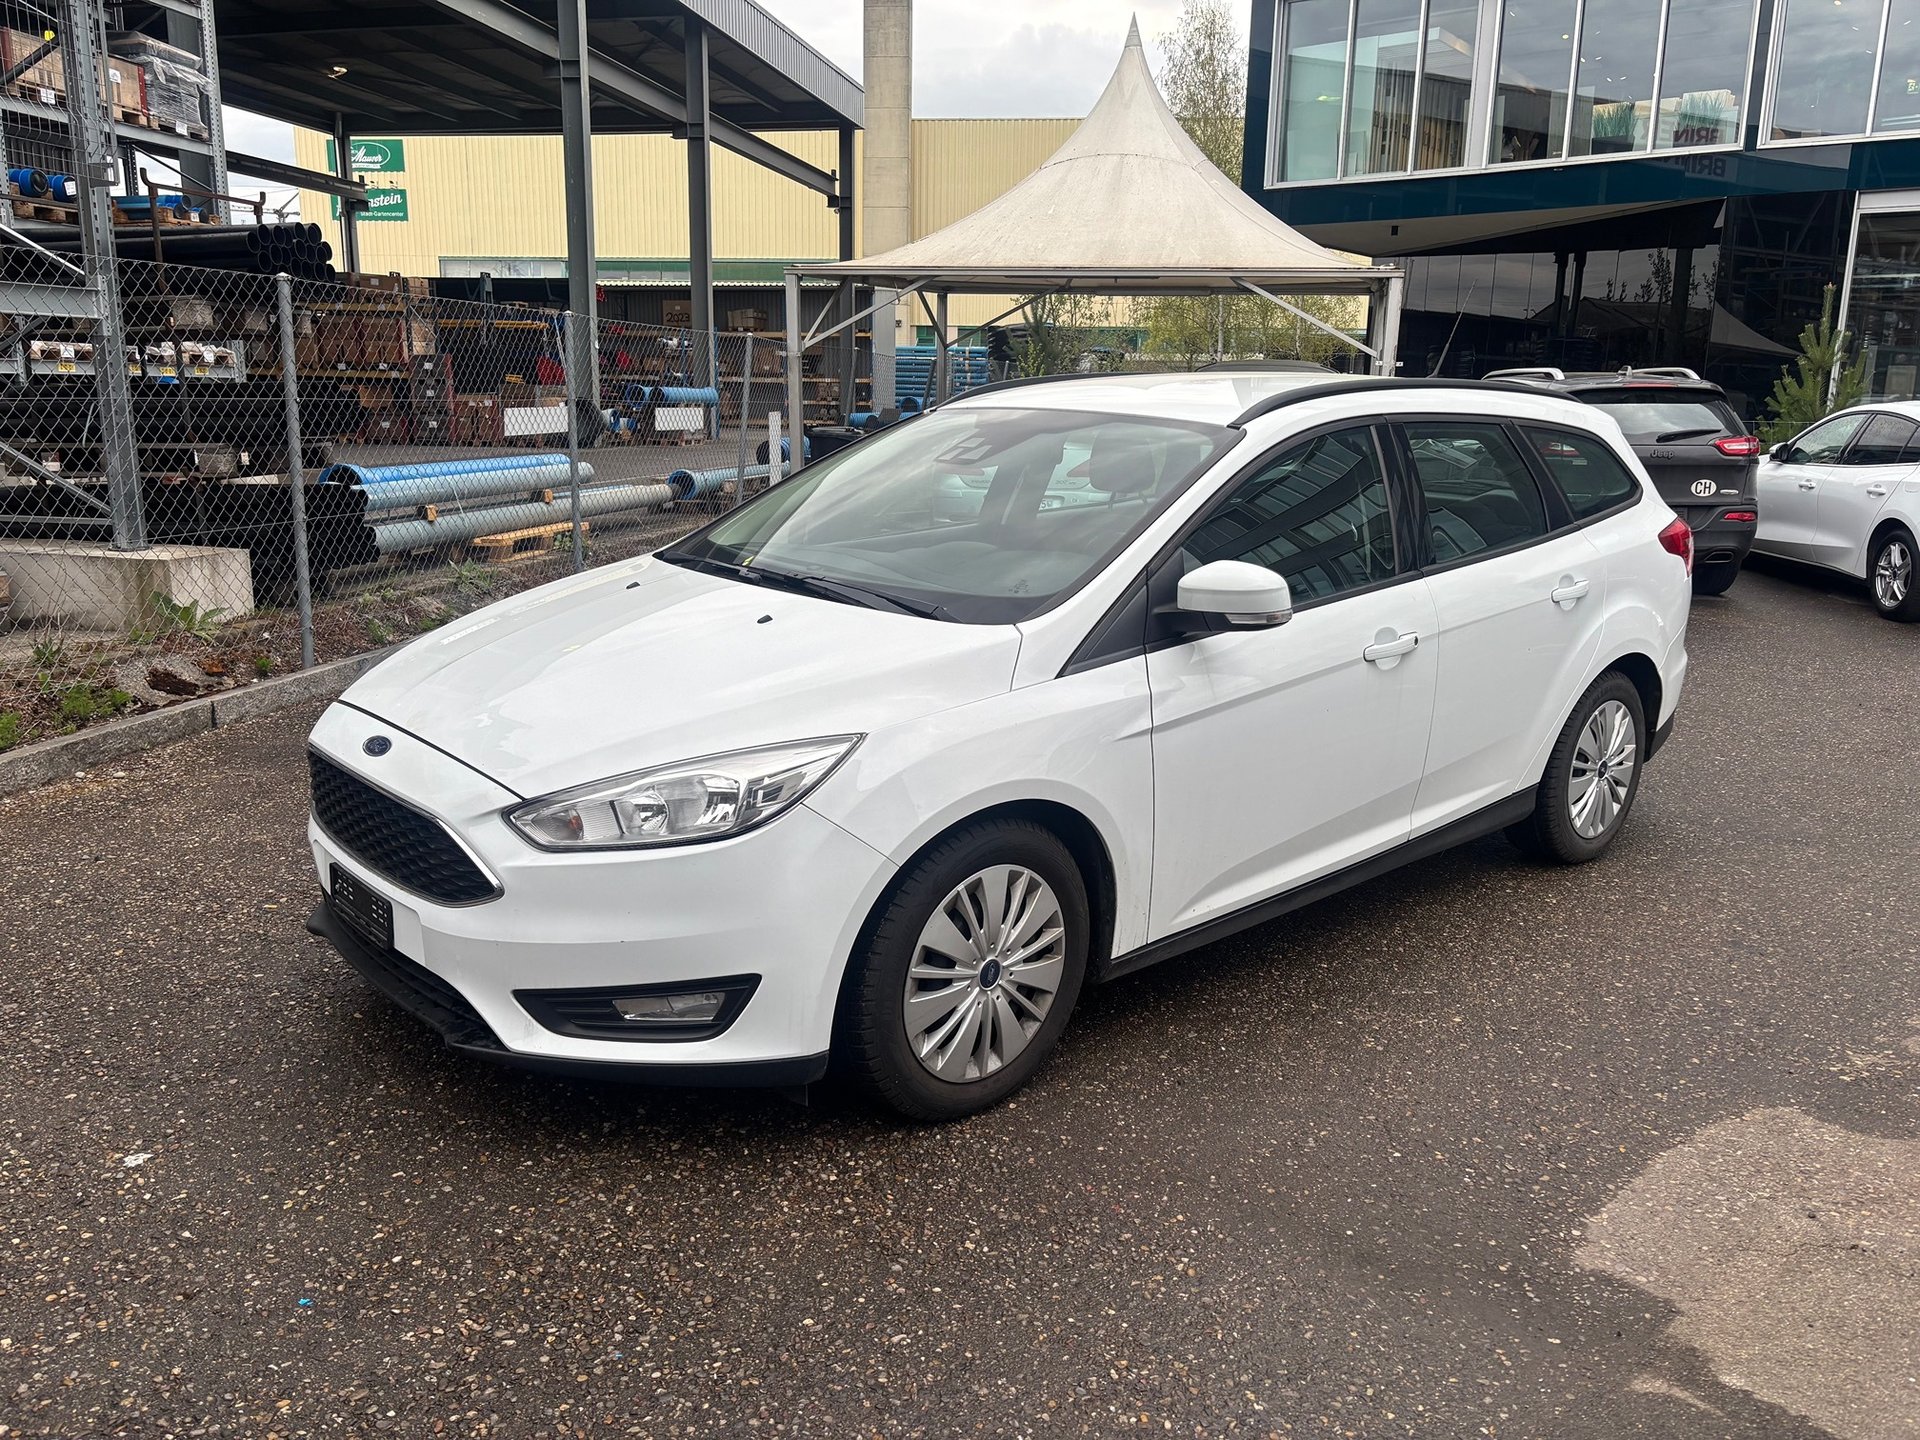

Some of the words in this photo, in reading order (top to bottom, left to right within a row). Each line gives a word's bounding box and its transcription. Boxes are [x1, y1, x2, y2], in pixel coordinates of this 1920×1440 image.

[665, 312, 690, 322] 2023
[1651, 450, 1674, 459] Jeep
[1694, 481, 1712, 495] CH
